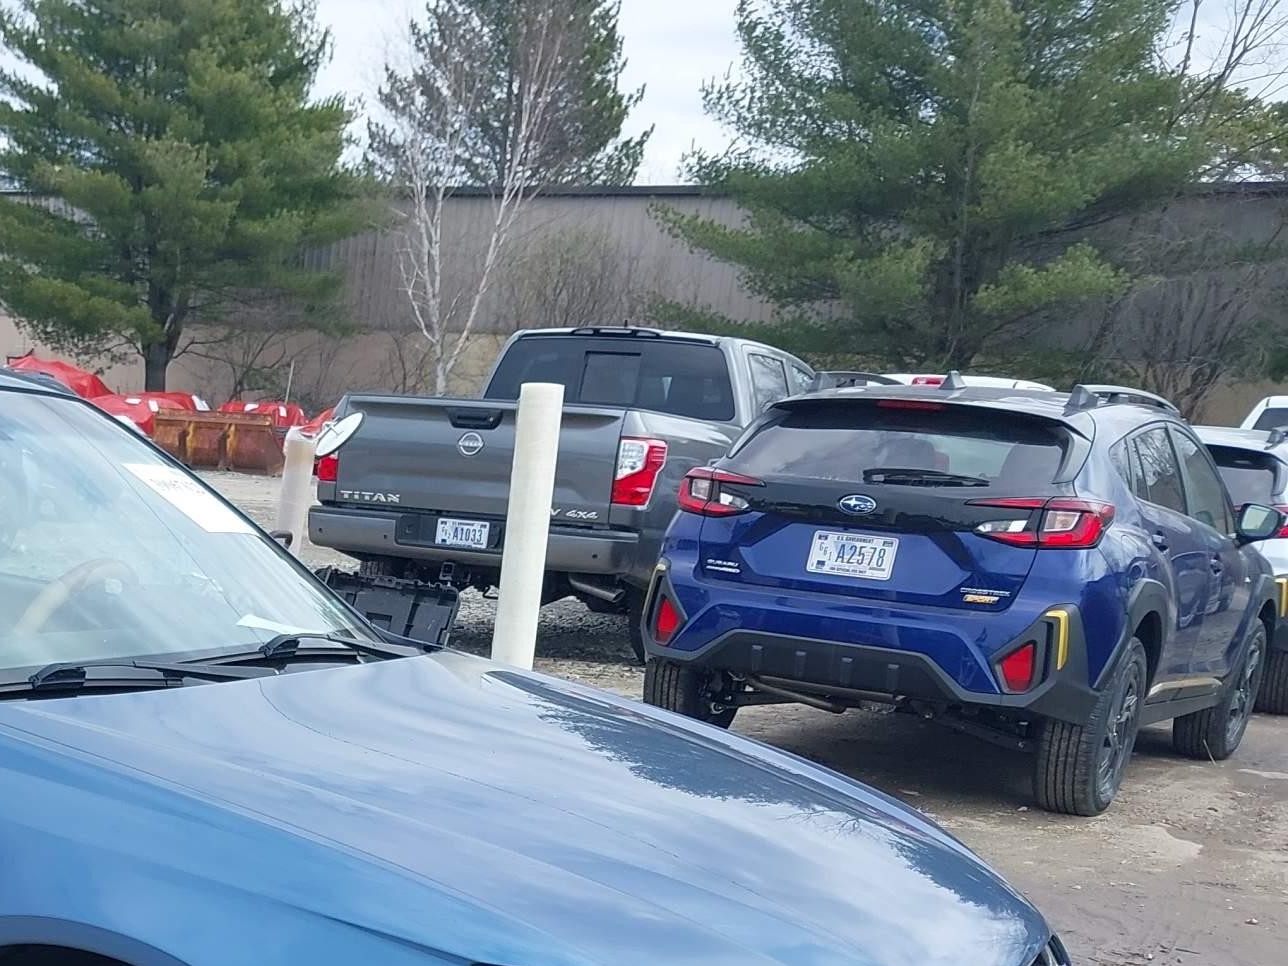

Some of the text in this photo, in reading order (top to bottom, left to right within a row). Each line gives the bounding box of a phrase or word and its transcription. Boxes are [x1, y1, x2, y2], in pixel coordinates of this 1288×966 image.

[339, 489, 401, 503] TITAN
[452, 526, 483, 542] A1033
[834, 543, 887, 568] A2578
